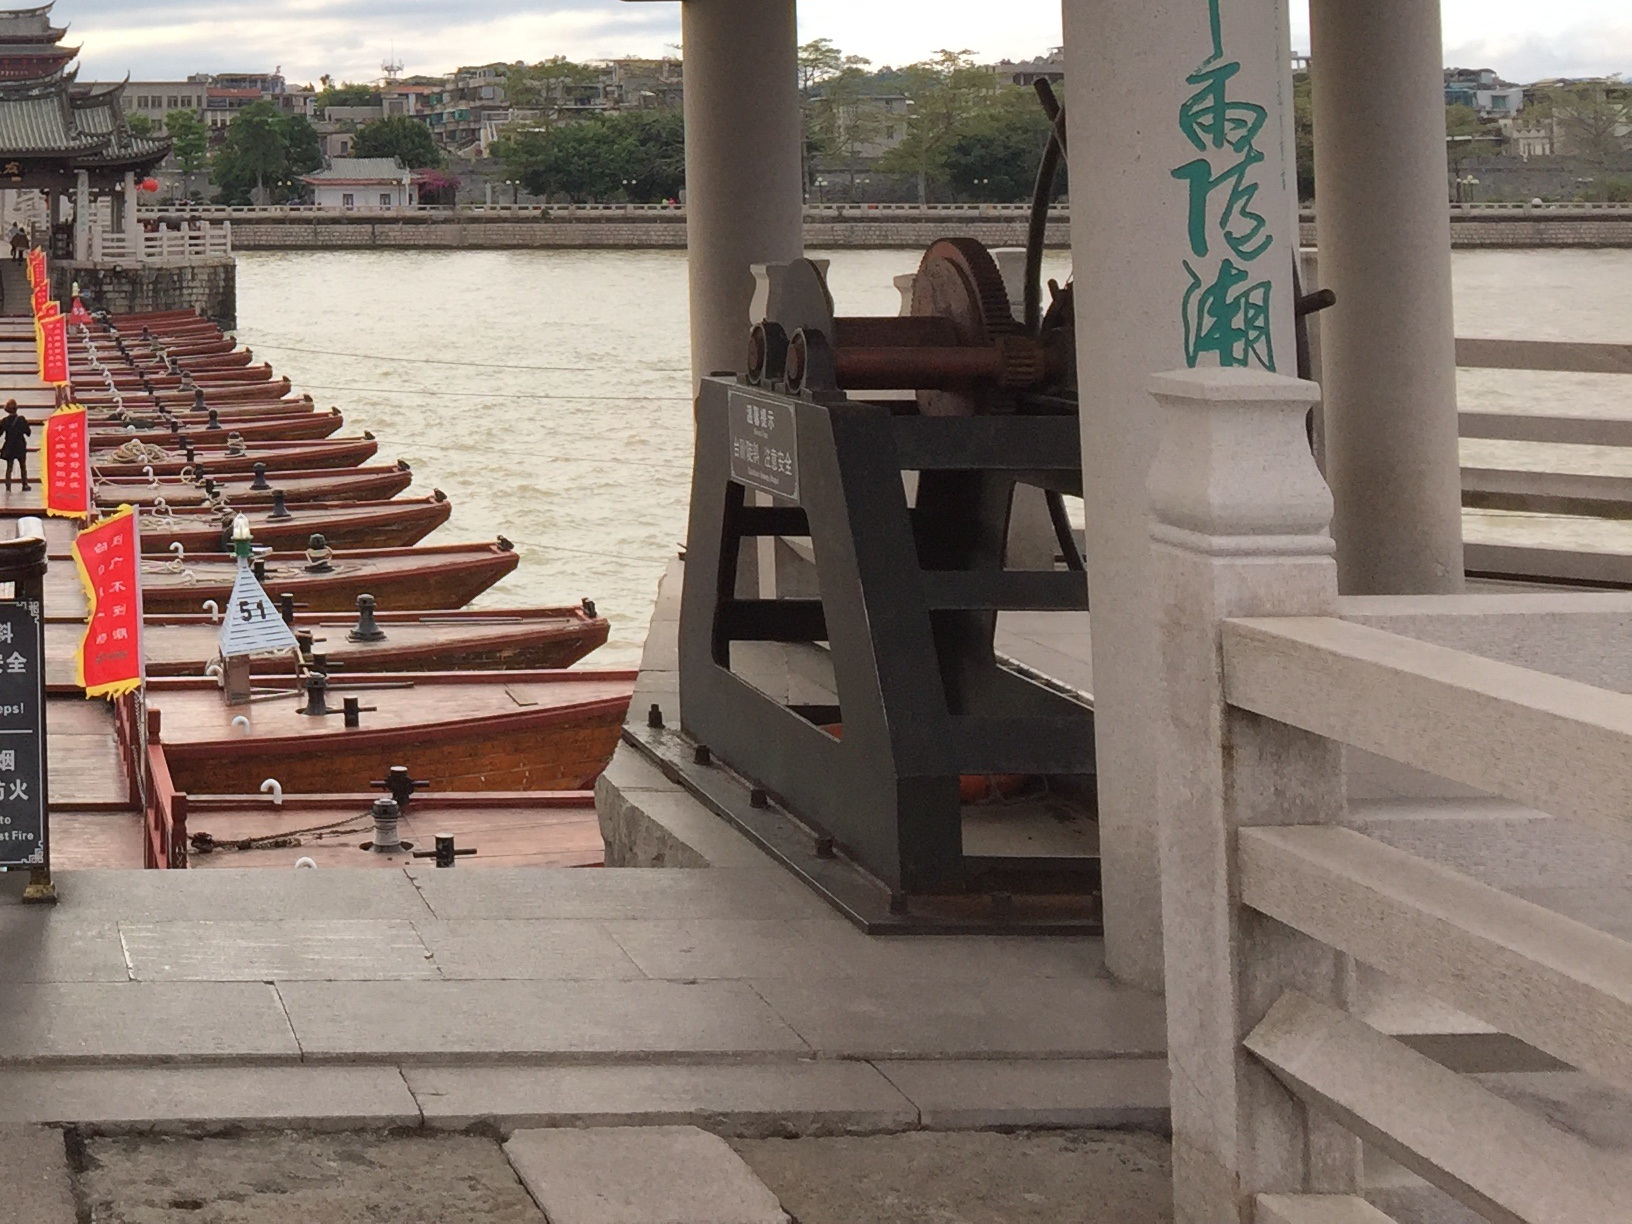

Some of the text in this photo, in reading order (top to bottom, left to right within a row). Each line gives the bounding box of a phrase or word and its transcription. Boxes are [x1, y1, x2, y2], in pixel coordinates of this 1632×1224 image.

[239, 599, 267, 621] 51
[0, 815, 12, 825] to
[11, 829, 34, 841] Fire
